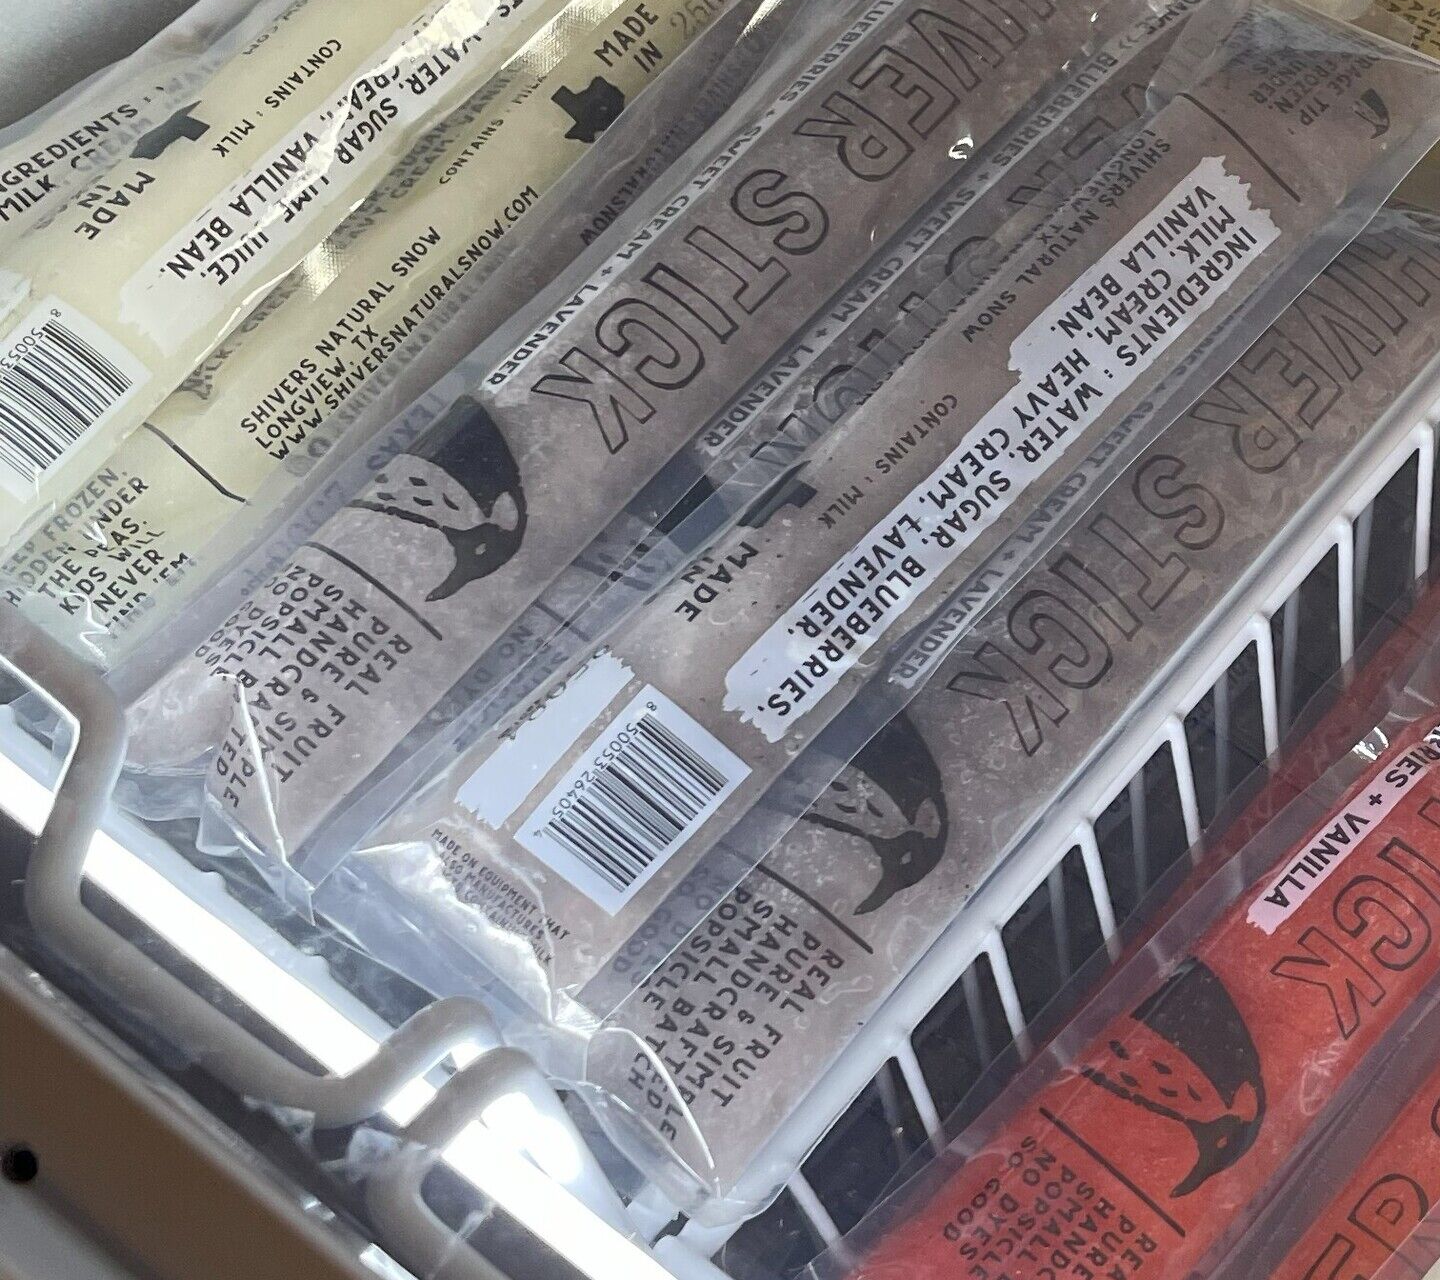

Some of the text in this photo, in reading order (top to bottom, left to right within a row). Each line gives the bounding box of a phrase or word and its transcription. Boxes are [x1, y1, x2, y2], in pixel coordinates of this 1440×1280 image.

[210, 35, 343, 160] CONTAINS MILK
[632, 38, 666, 73] IN
[72, 164, 156, 245] MADE
[158, 128, 323, 286] VANILLA BEAN.
[701, 40, 1118, 450] BLUEBERRIES SWEET CREAM LAVENDER
[960, 136, 1172, 343] SHIVERS NATURAL SNOW
[1049, 182, 1215, 344] VANILLA BEAN.
[239, 359, 318, 433] SHIVERS
[315, 279, 395, 355] NATURAL
[391, 223, 443, 279] SNOW
[754, 226, 1257, 732] INGREDIENTS WATER, SUGAR, BLUEBERRIES,
[817, 391, 959, 530] CONTAINS MILK
[94, 546, 164, 612] NEVER
[256, 578, 345, 669] SMALL
[673, 535, 759, 627] MADE
[945, 443, 1240, 755] STICK
[1263, 802, 1370, 918] VANILLA
[616, 896, 773, 1089] SMALL BATCH
[648, 928, 820, 1141] PURE SIMPLE
[707, 947, 844, 1108] REAL FRUIT
[1016, 1176, 1096, 1266] SMALL
